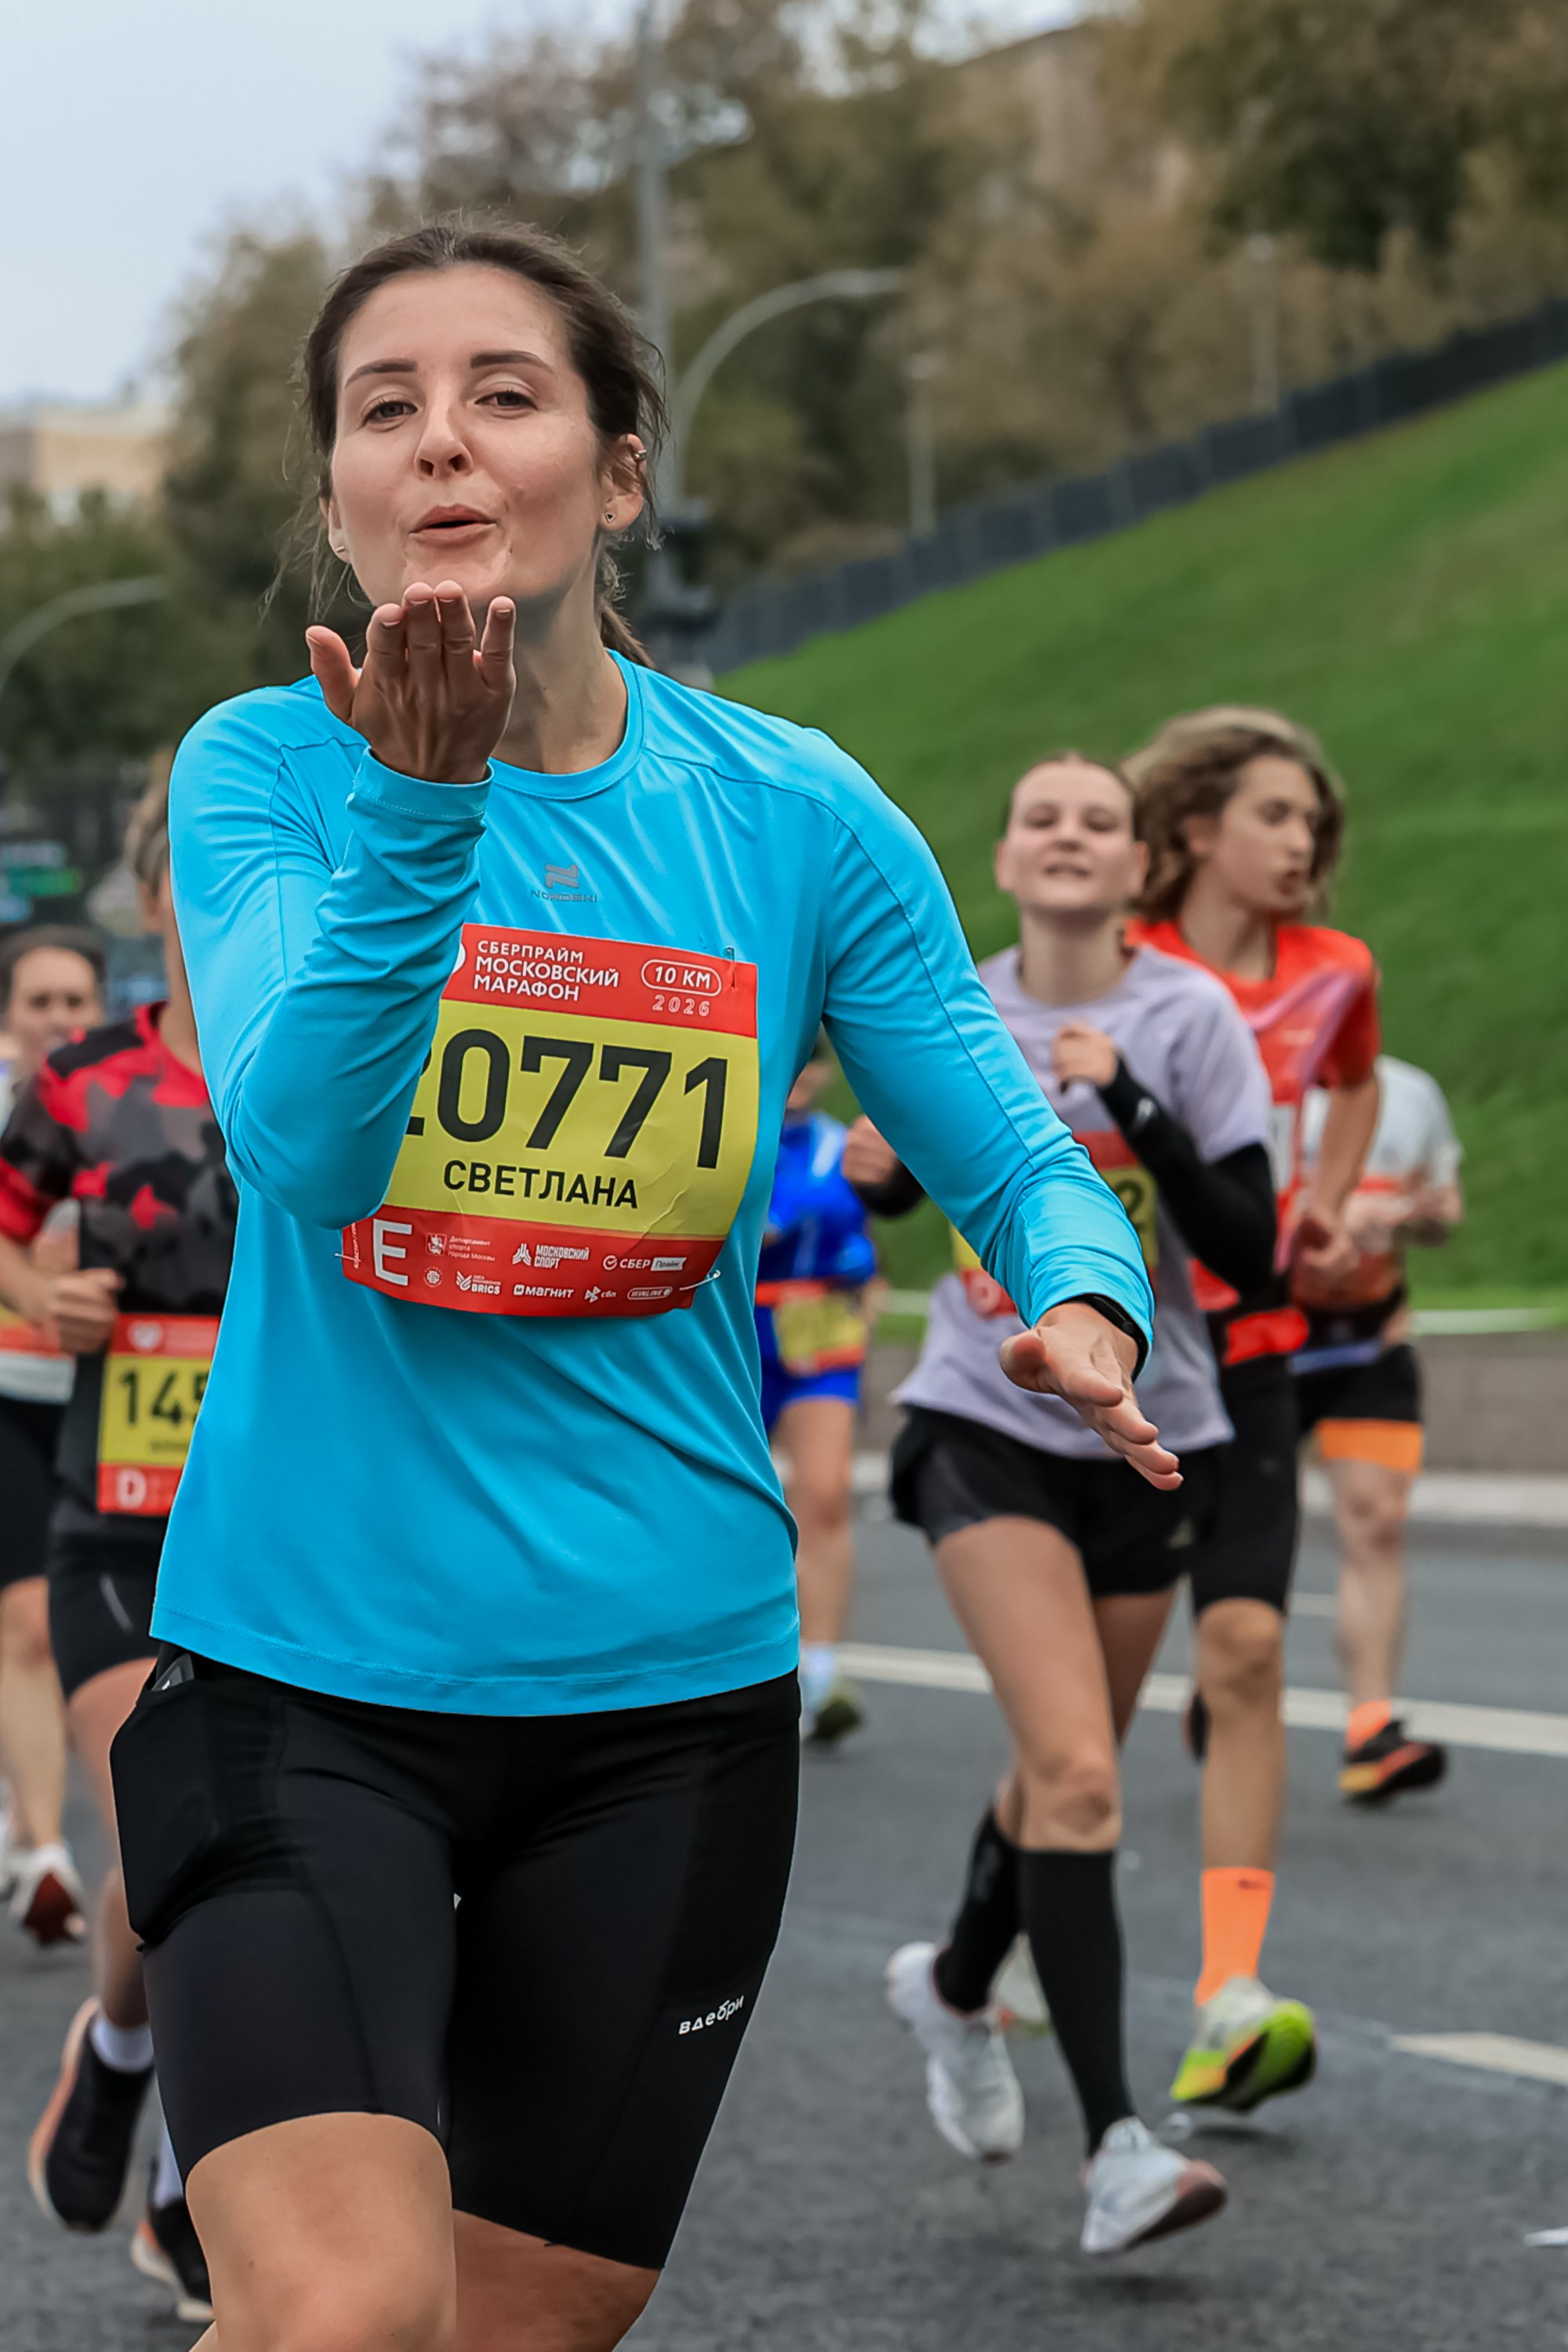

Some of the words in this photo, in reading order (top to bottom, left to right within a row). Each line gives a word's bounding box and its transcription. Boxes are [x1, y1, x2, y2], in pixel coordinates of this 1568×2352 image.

[531, 890, 597, 903] NORDSKI
[477, 940, 583, 964] СБЕРПРАЙМ
[475, 956, 619, 988] МОСКОВСКИЙ
[655, 966, 677, 984] 10
[474, 974, 579, 1002] МАРАФОН
[652, 994, 710, 1017] 2026
[443, 1160, 638, 1209] СВЕТЛАНА
[372, 1218, 412, 1287] E
[534, 1256, 561, 1269] СПОРТ
[535, 1244, 590, 1261] МОСКОВСКИЙ
[619, 1258, 651, 1269] СБЕР
[471, 1283, 500, 1295] BRICS
